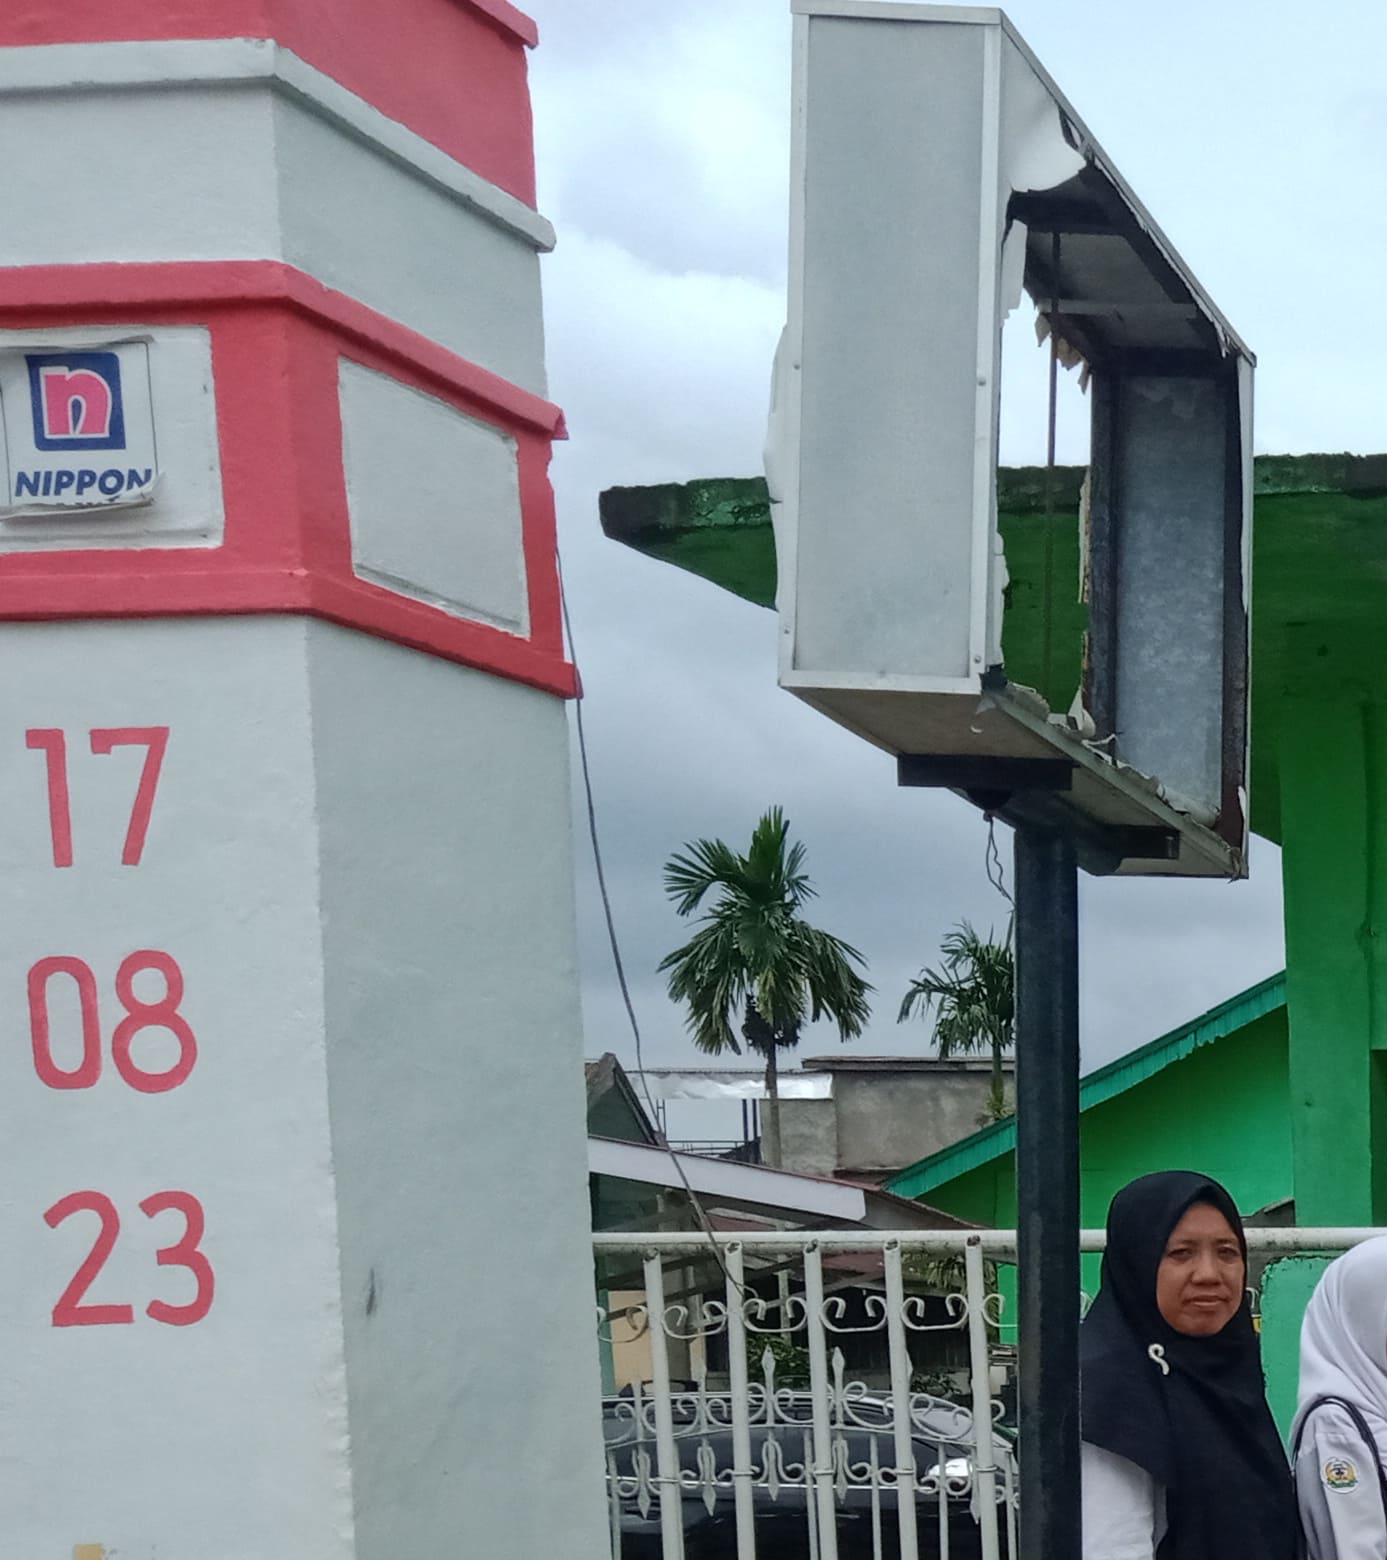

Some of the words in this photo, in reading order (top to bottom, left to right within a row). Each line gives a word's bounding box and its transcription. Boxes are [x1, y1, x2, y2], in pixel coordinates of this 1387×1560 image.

[15, 469, 152, 497] NIPPON
[25, 725, 170, 868] 17
[27, 950, 197, 1093] 08
[43, 1191, 215, 1326] 23
